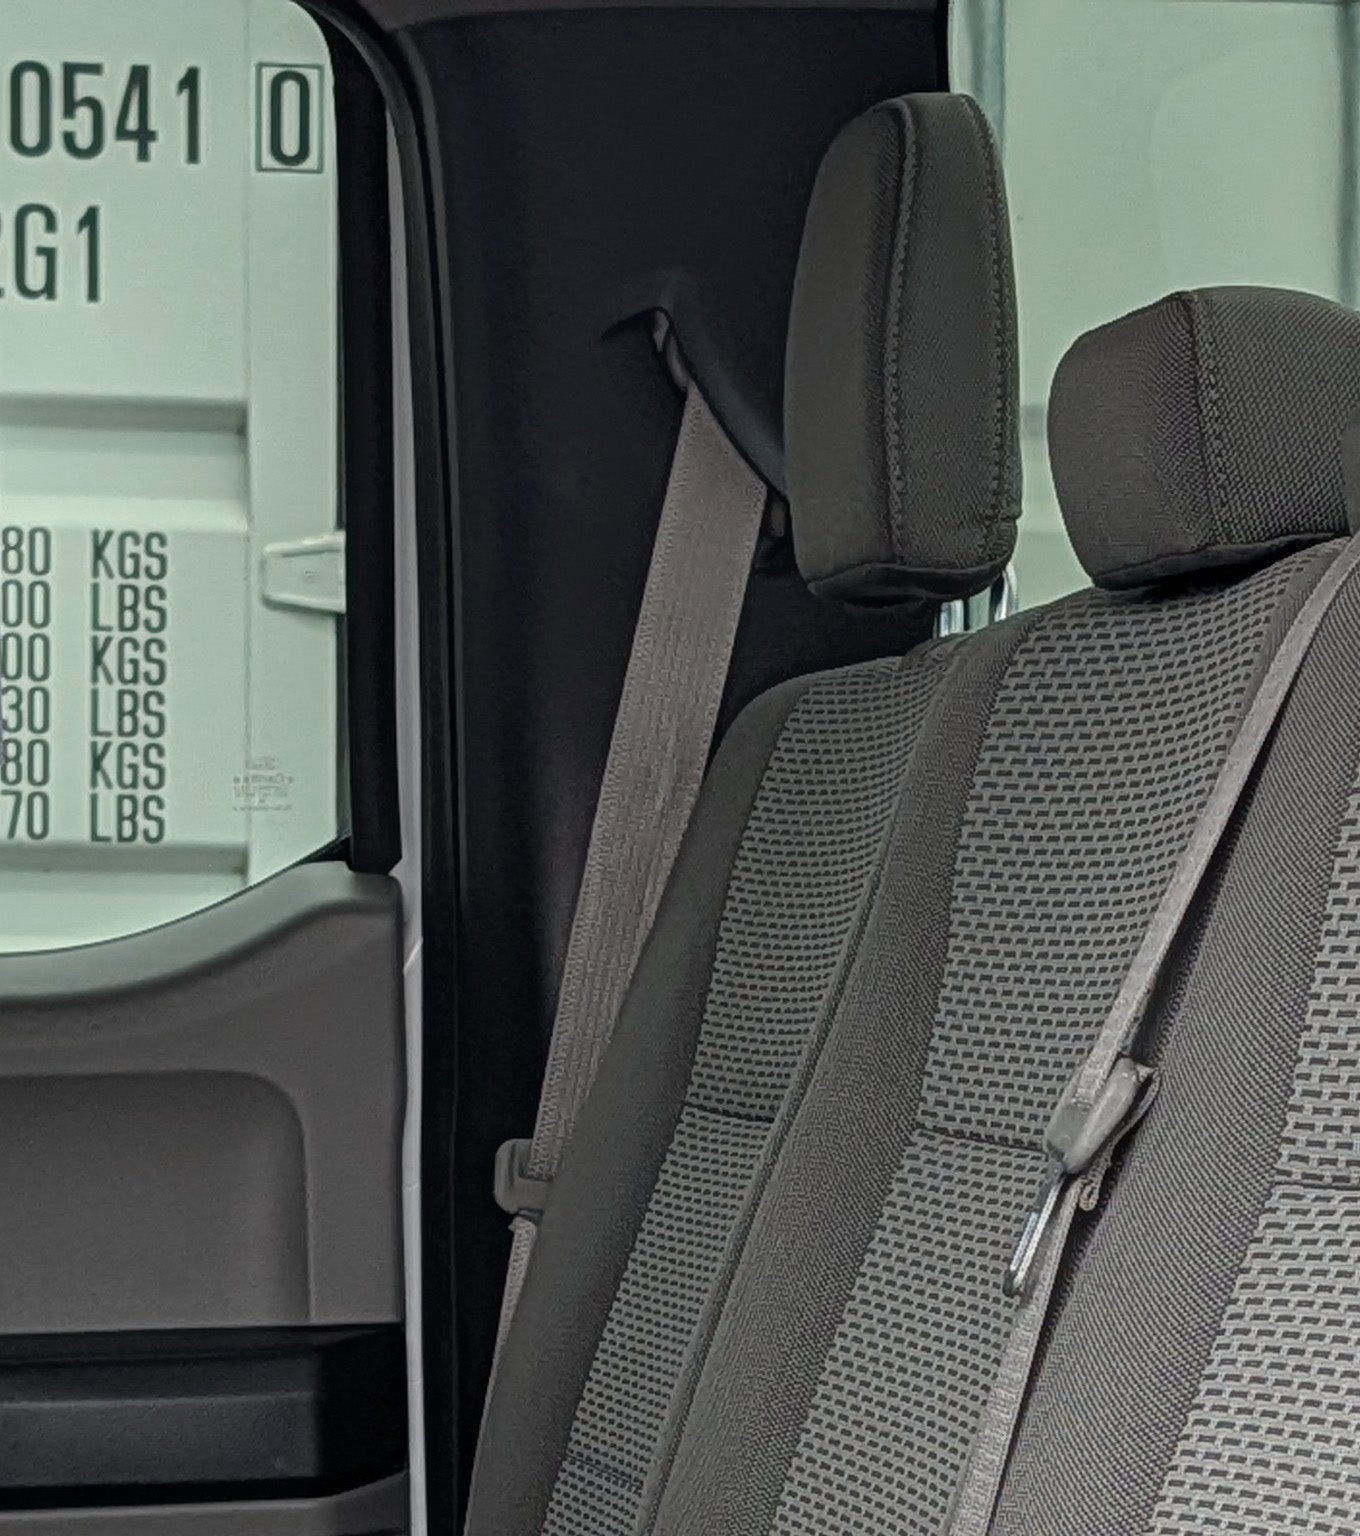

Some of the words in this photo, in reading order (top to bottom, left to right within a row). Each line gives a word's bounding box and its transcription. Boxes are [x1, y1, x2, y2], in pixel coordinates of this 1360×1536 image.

[270, 70, 311, 167] 0
[1, 526, 51, 576] 80
[93, 529, 168, 581] KGS
[1, 579, 51, 629] 00
[93, 582, 167, 634] LBS
[1, 632, 51, 682] 00
[92, 635, 167, 687] KGS
[2, 685, 50, 735] 30
[92, 687, 167, 739] LBS
[92, 741, 167, 790] KGS
[92, 793, 167, 844] LBS
